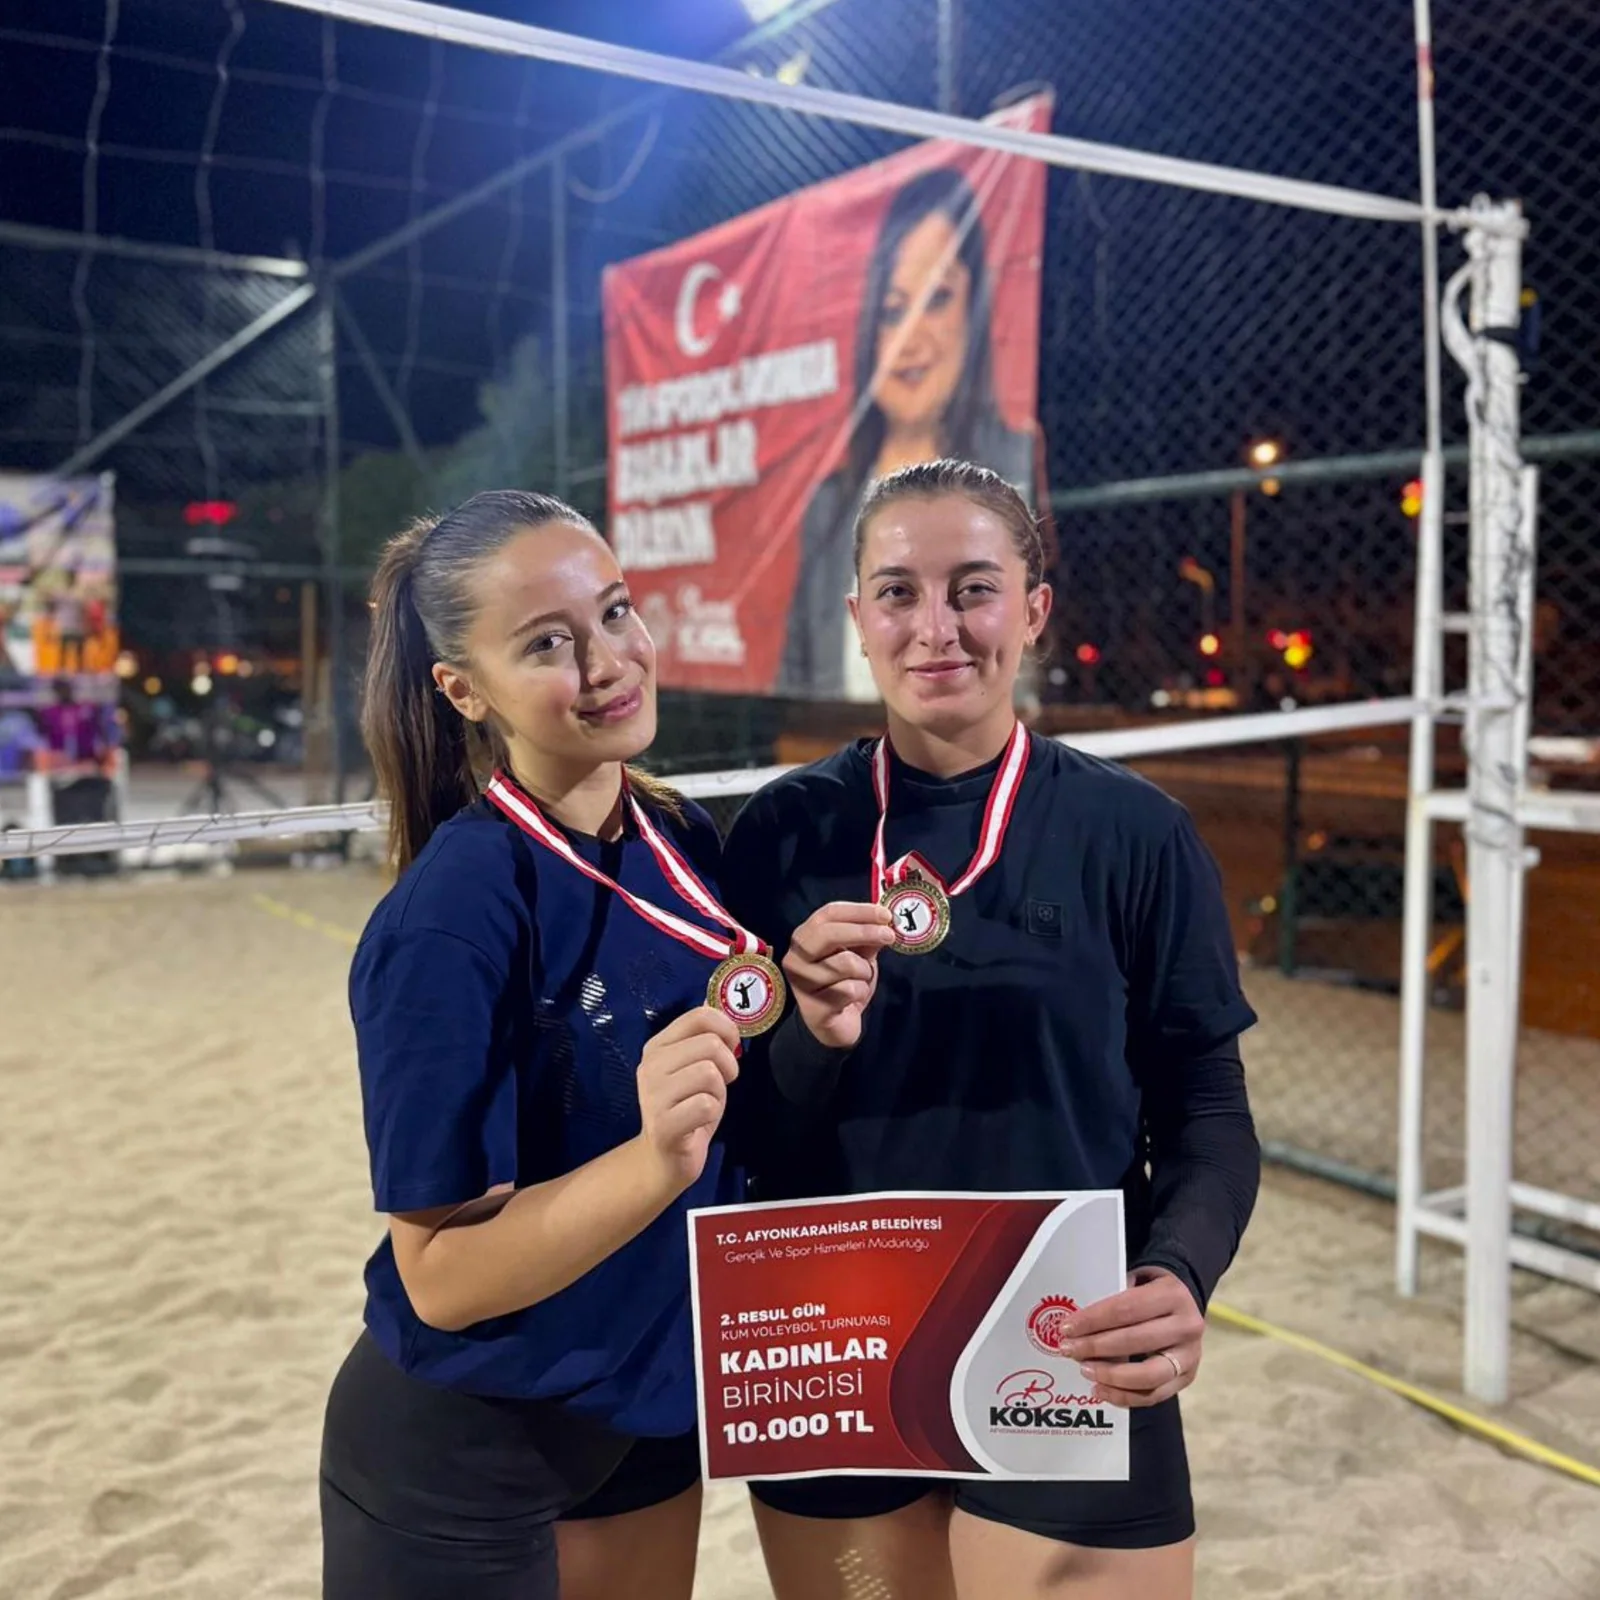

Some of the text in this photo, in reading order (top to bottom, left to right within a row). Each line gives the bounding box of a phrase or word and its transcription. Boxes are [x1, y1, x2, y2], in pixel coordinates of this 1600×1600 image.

[716, 1216, 942, 1246] T.C. AFYONKARAHİSAR BELEDİYESİ
[768, 1247, 783, 1258] Ve
[785, 1245, 811, 1260] Spor
[720, 1303, 826, 1326] 2. RESUL GÜN
[721, 1315, 891, 1341] KUM VOLEYBOL TURNUVASI
[720, 1336, 888, 1375] KADINLAR
[722, 1367, 863, 1409] BİRİNCİSİ
[996, 1369, 1104, 1409] Burcu
[723, 1410, 875, 1445] 10.000 TL
[989, 1401, 1114, 1428] KÖKSAL
